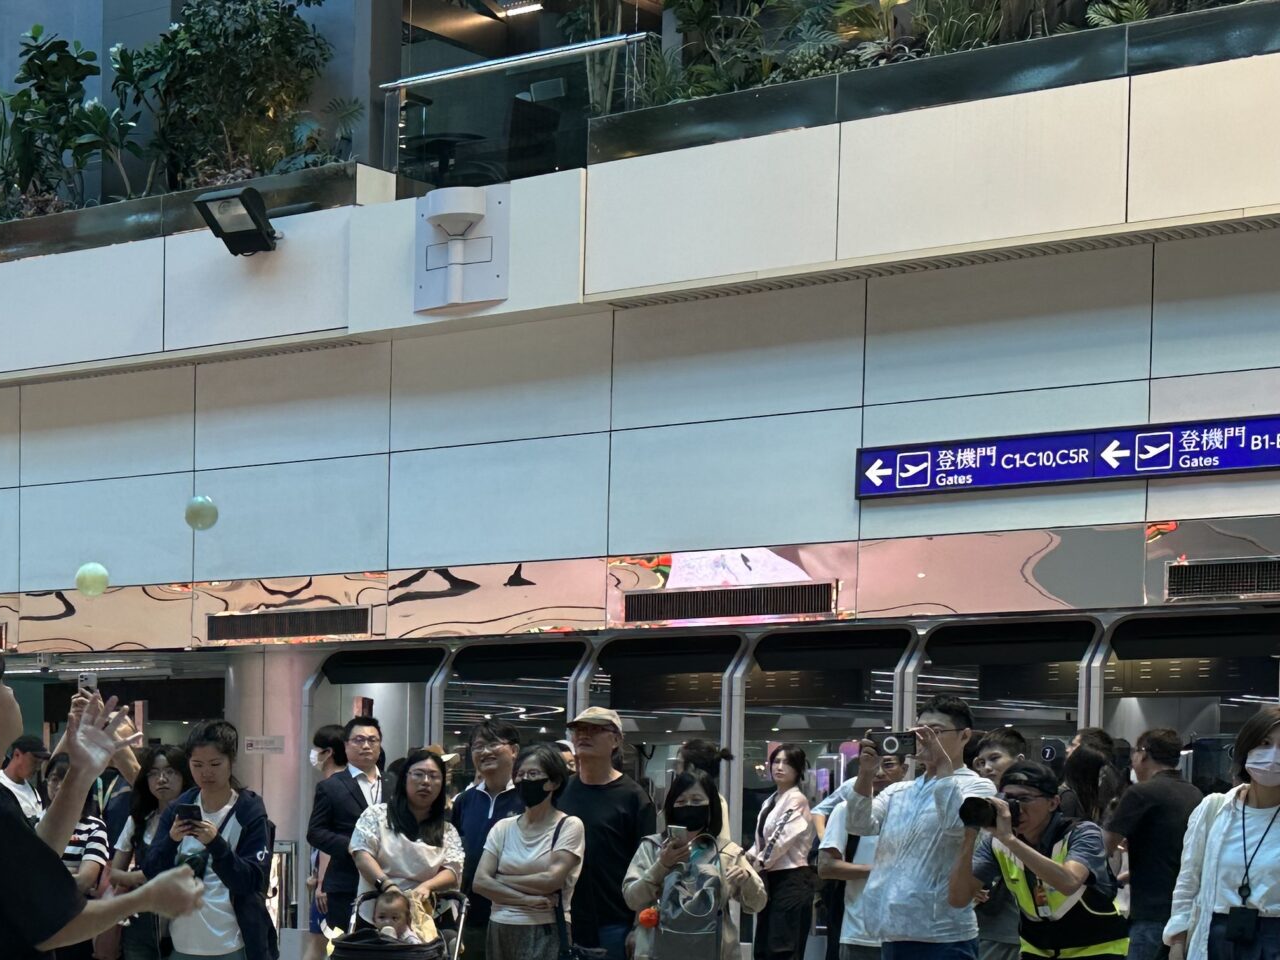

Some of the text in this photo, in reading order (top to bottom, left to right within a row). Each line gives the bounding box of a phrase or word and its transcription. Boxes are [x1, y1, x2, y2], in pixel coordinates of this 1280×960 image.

[1178, 426, 1246, 452] 登機門
[935, 446, 1089, 471] 登機門 C1-C10,C5R
[1179, 455, 1220, 468] Gates
[935, 473, 973, 486] Gates
